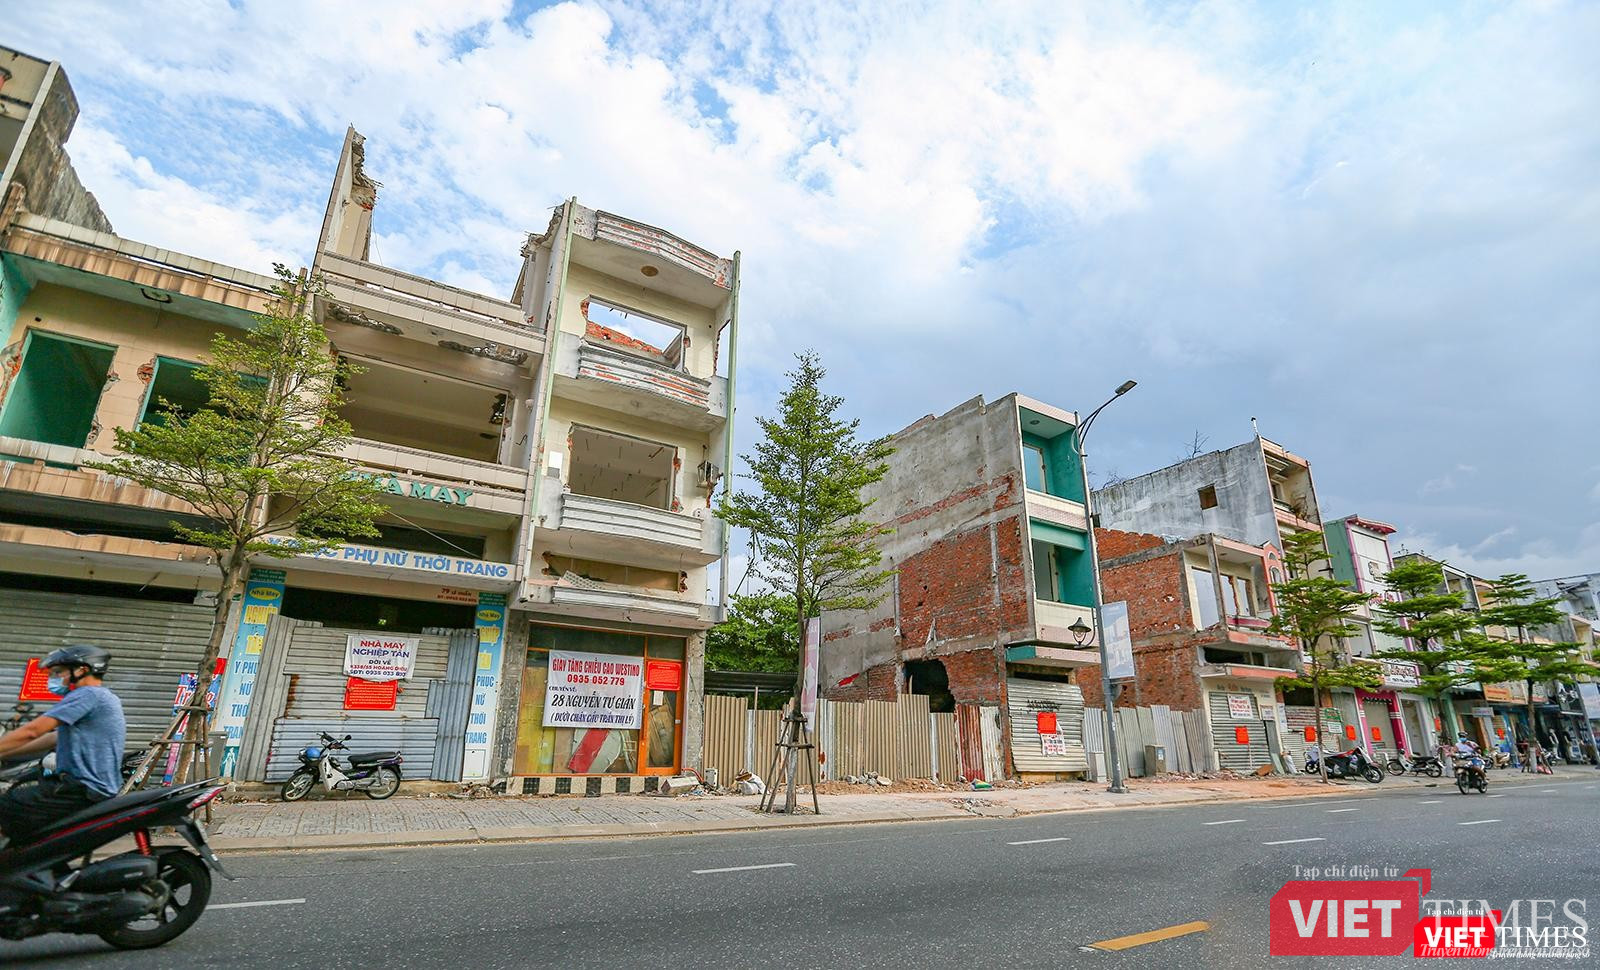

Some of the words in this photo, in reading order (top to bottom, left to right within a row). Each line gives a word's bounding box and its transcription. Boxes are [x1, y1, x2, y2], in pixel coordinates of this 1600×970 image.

[410, 480, 473, 507] MAY
[343, 547, 379, 567] PHỤ
[383, 549, 409, 567] NỮ
[413, 555, 451, 571] THỜI
[456, 560, 508, 578] TRANG
[360, 639, 382, 648] NHÀ
[383, 641, 405, 649] MAY
[352, 648, 389, 658] NGHIỆP
[602, 663, 614, 675] CAO
[567, 674, 589, 684] 0935
[592, 675, 608, 685] 052
[610, 677, 625, 686] 779
[551, 694, 565, 707] 28
[565, 691, 602, 708] NGUYỄN
